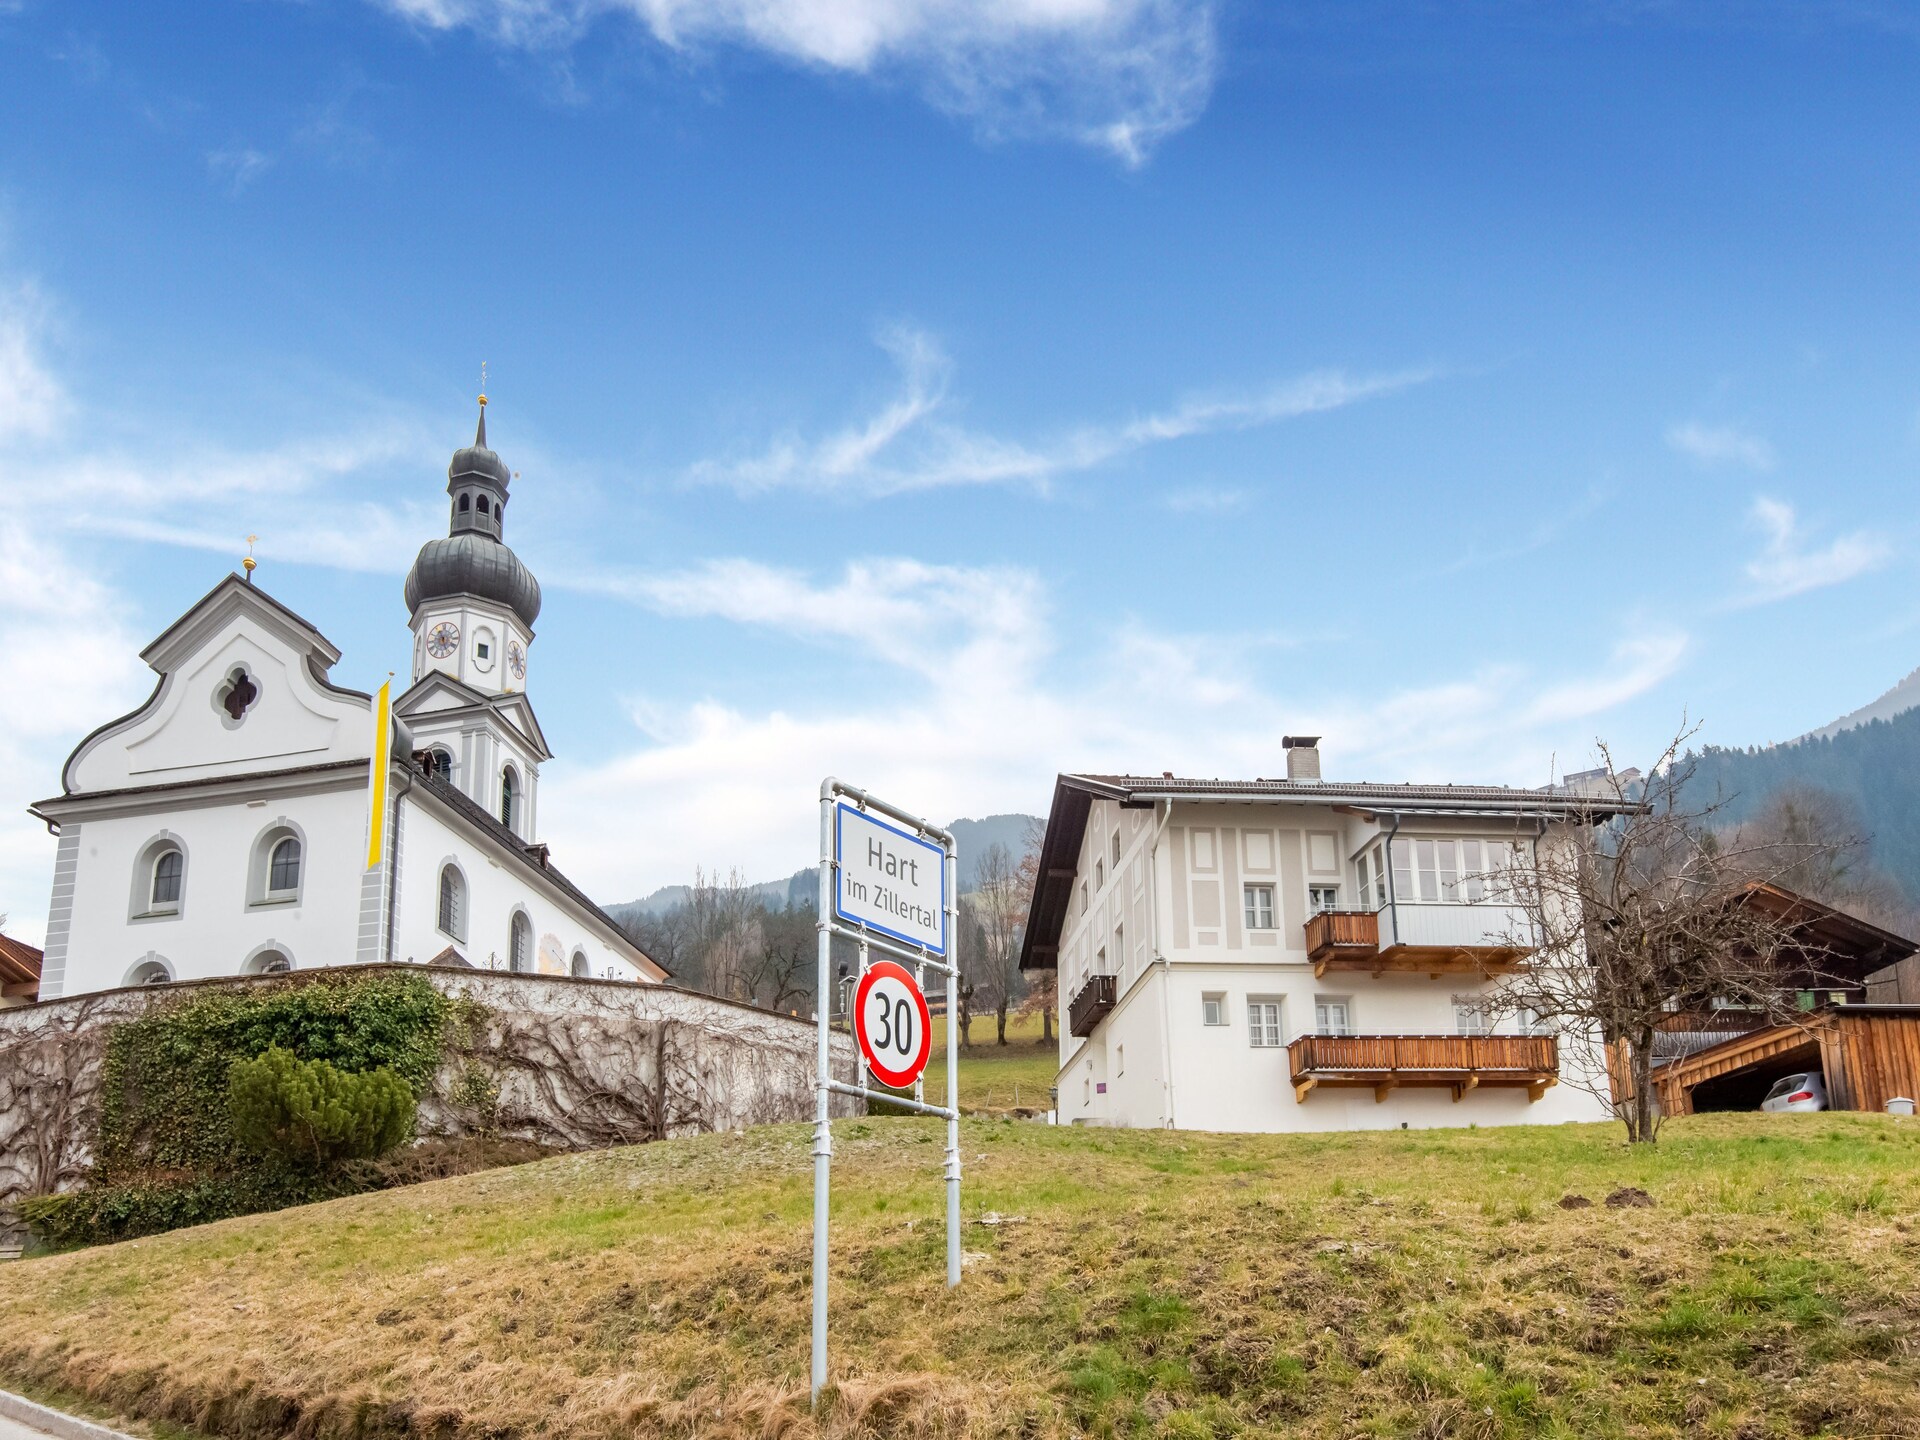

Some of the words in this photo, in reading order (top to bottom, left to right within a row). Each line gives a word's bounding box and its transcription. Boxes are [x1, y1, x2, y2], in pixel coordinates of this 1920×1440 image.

[868, 837, 918, 886] Hart
[847, 872, 867, 903] im
[874, 885, 937, 930] Zillertal
[874, 991, 912, 1056] 30
